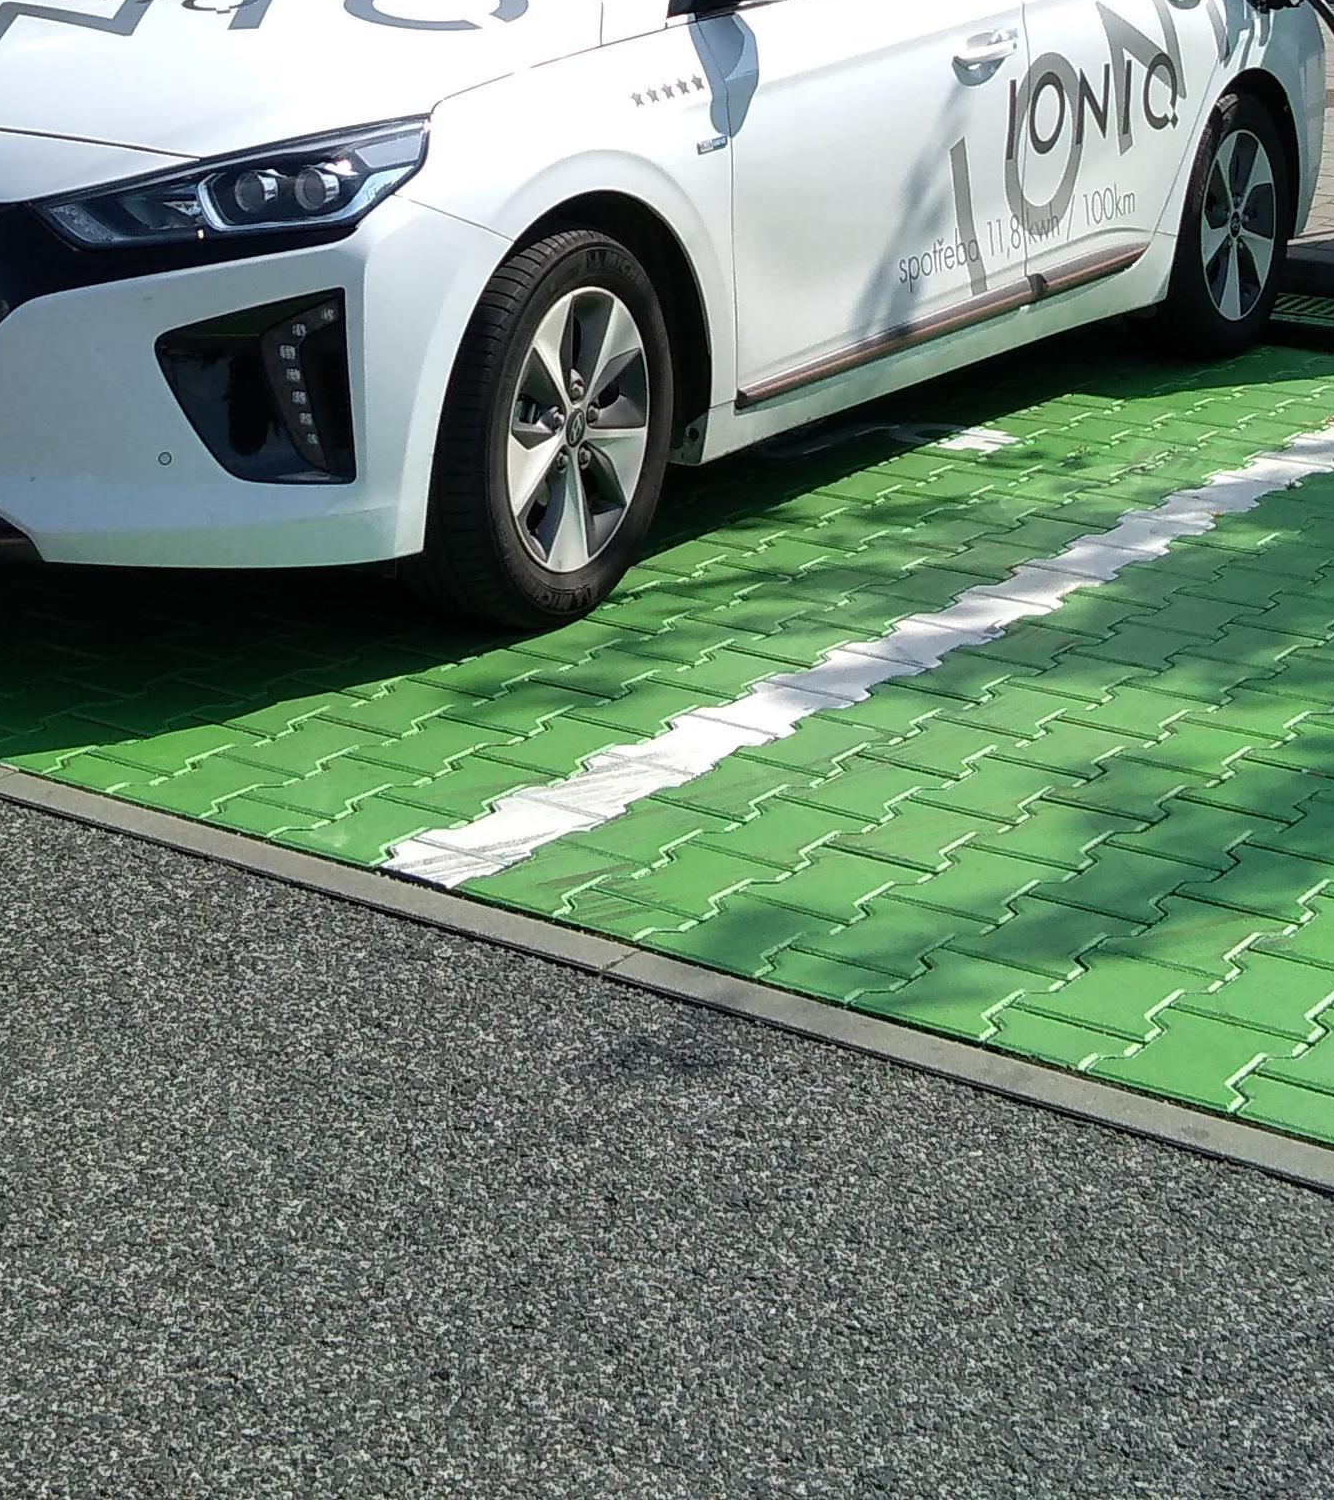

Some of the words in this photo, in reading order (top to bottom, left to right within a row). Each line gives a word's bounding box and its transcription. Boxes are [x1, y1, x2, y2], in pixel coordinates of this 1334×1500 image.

[1005, 52, 1180, 162] IONIQ
[898, 227, 981, 293] spotřeba
[986, 213, 1022, 260] 11,8
[1082, 184, 1136, 227] 100km
